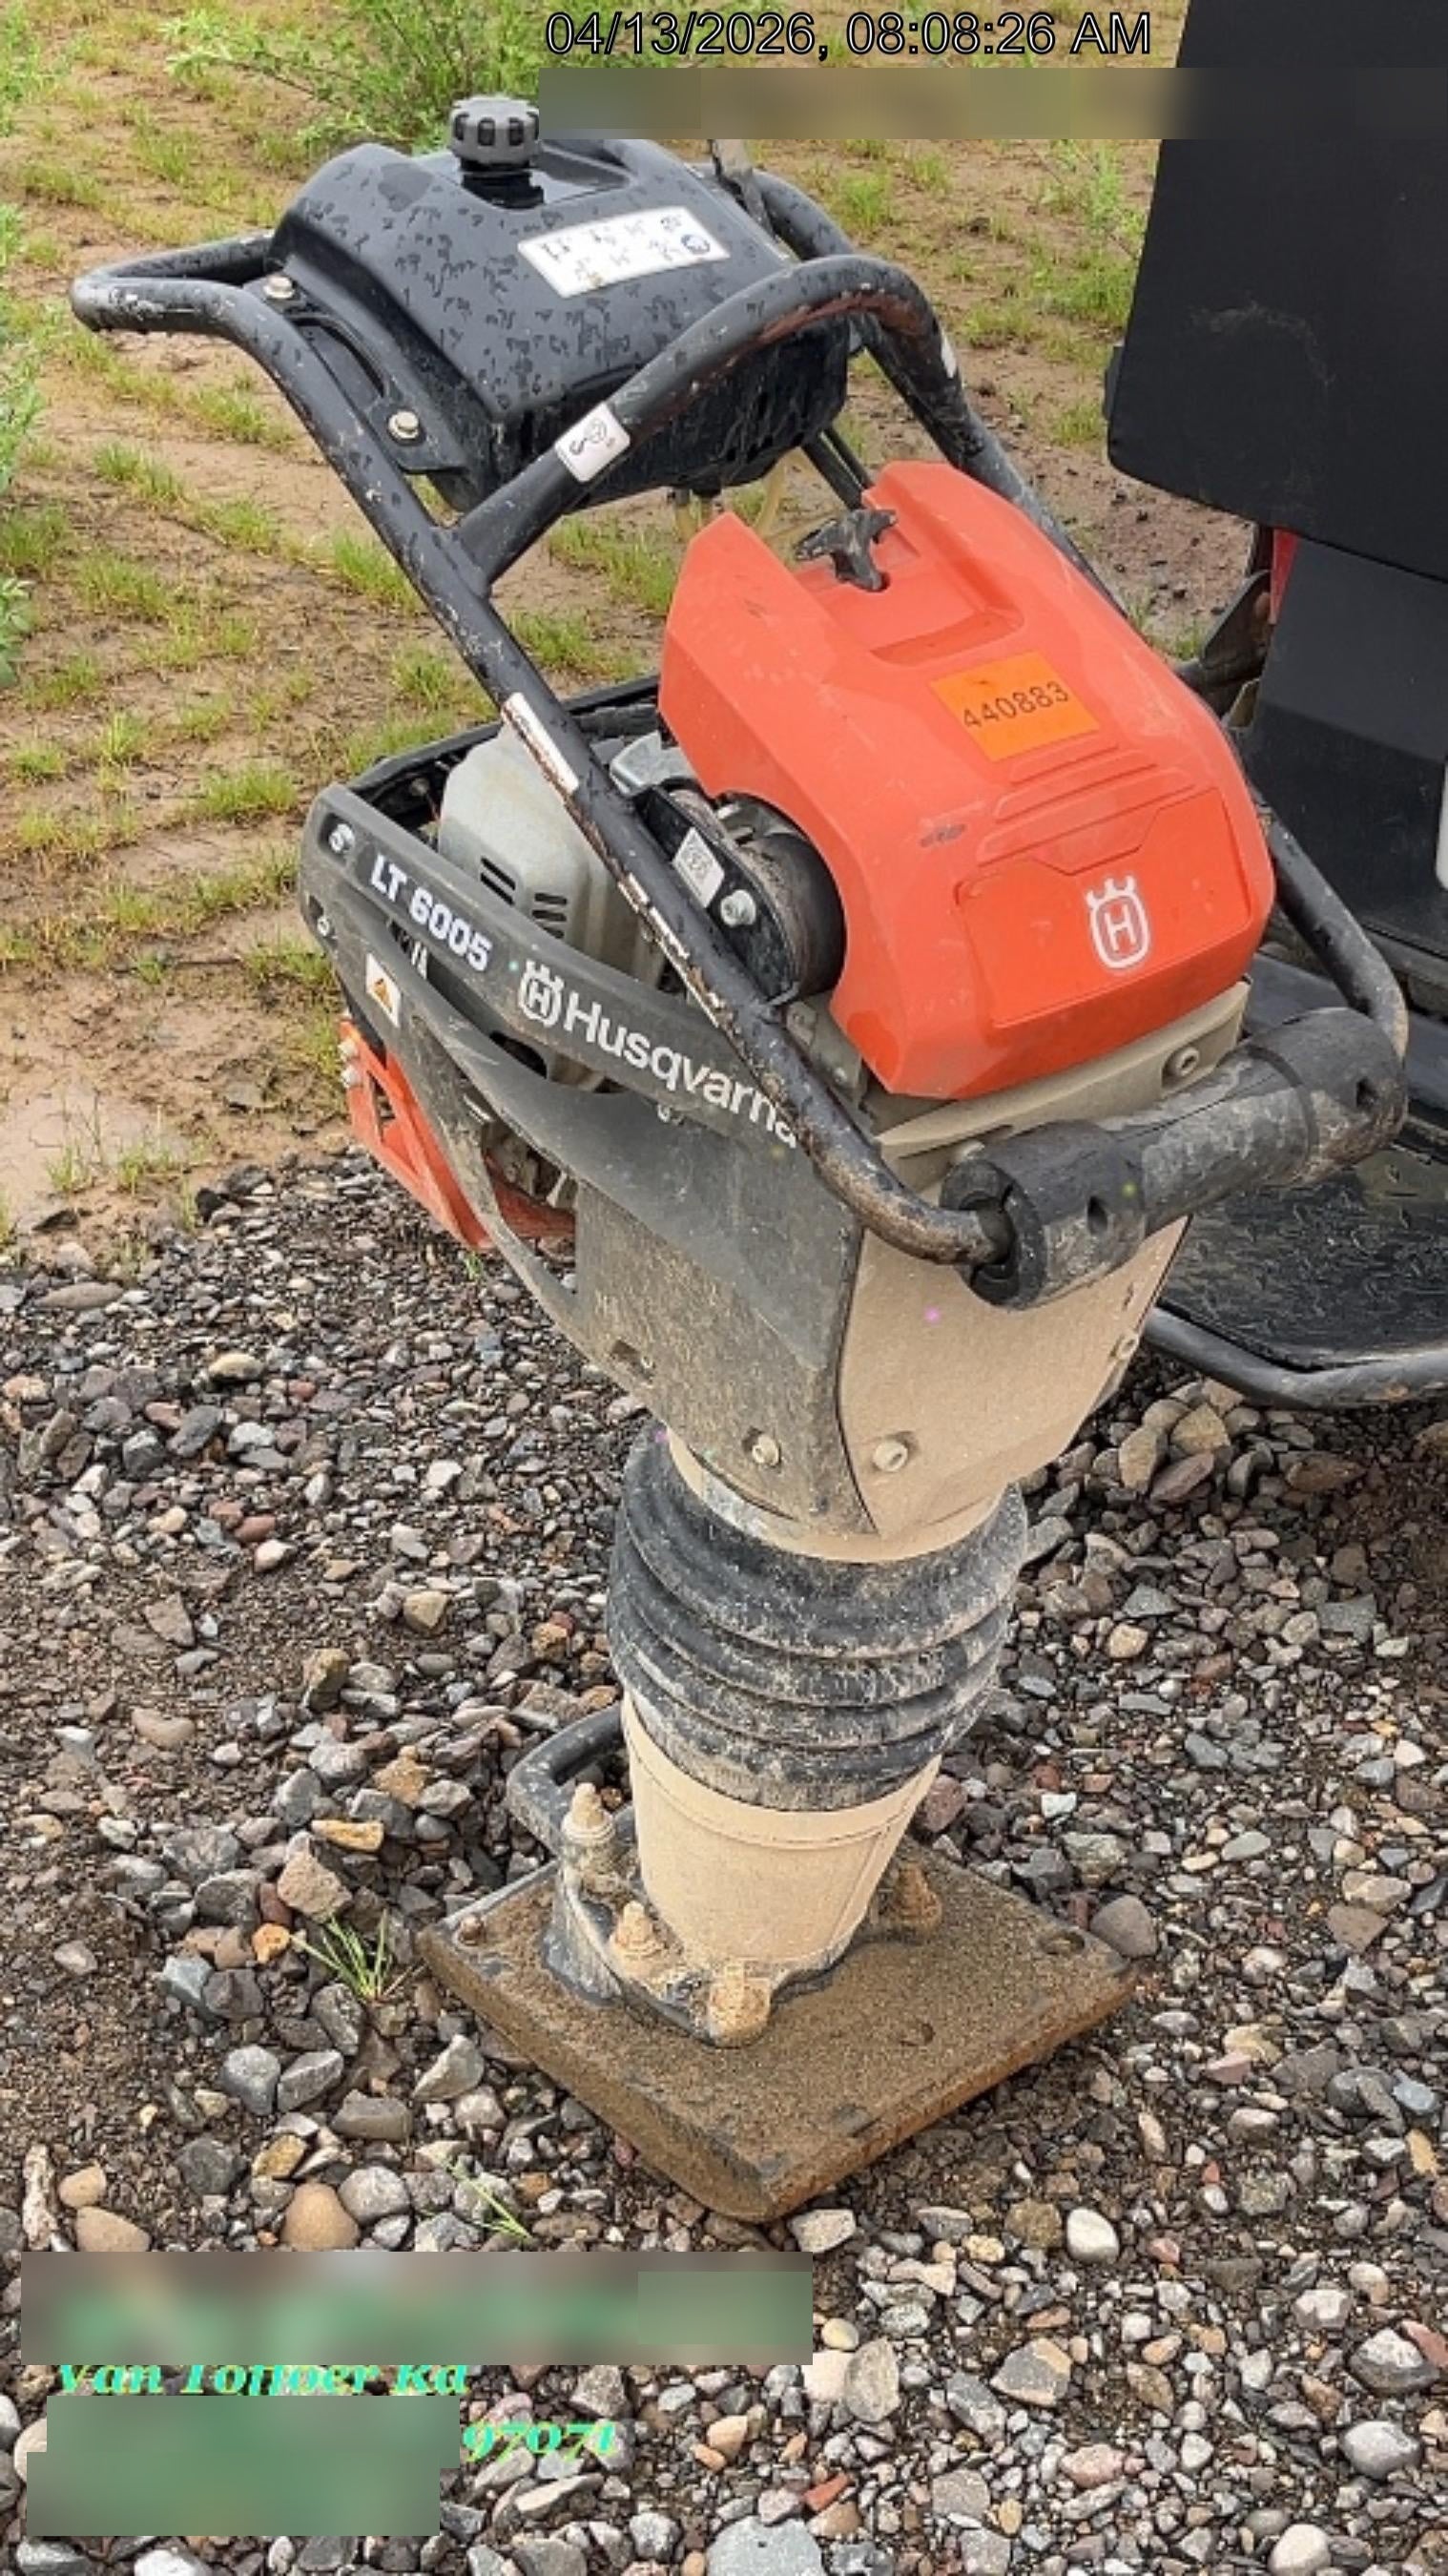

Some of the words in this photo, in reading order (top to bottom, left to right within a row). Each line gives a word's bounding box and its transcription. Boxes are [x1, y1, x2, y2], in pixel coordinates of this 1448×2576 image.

[963, 681, 1069, 728] 440883
[371, 853, 408, 903] LT
[409, 886, 493, 972] 6005
[563, 990, 796, 1149] Husqvarna
